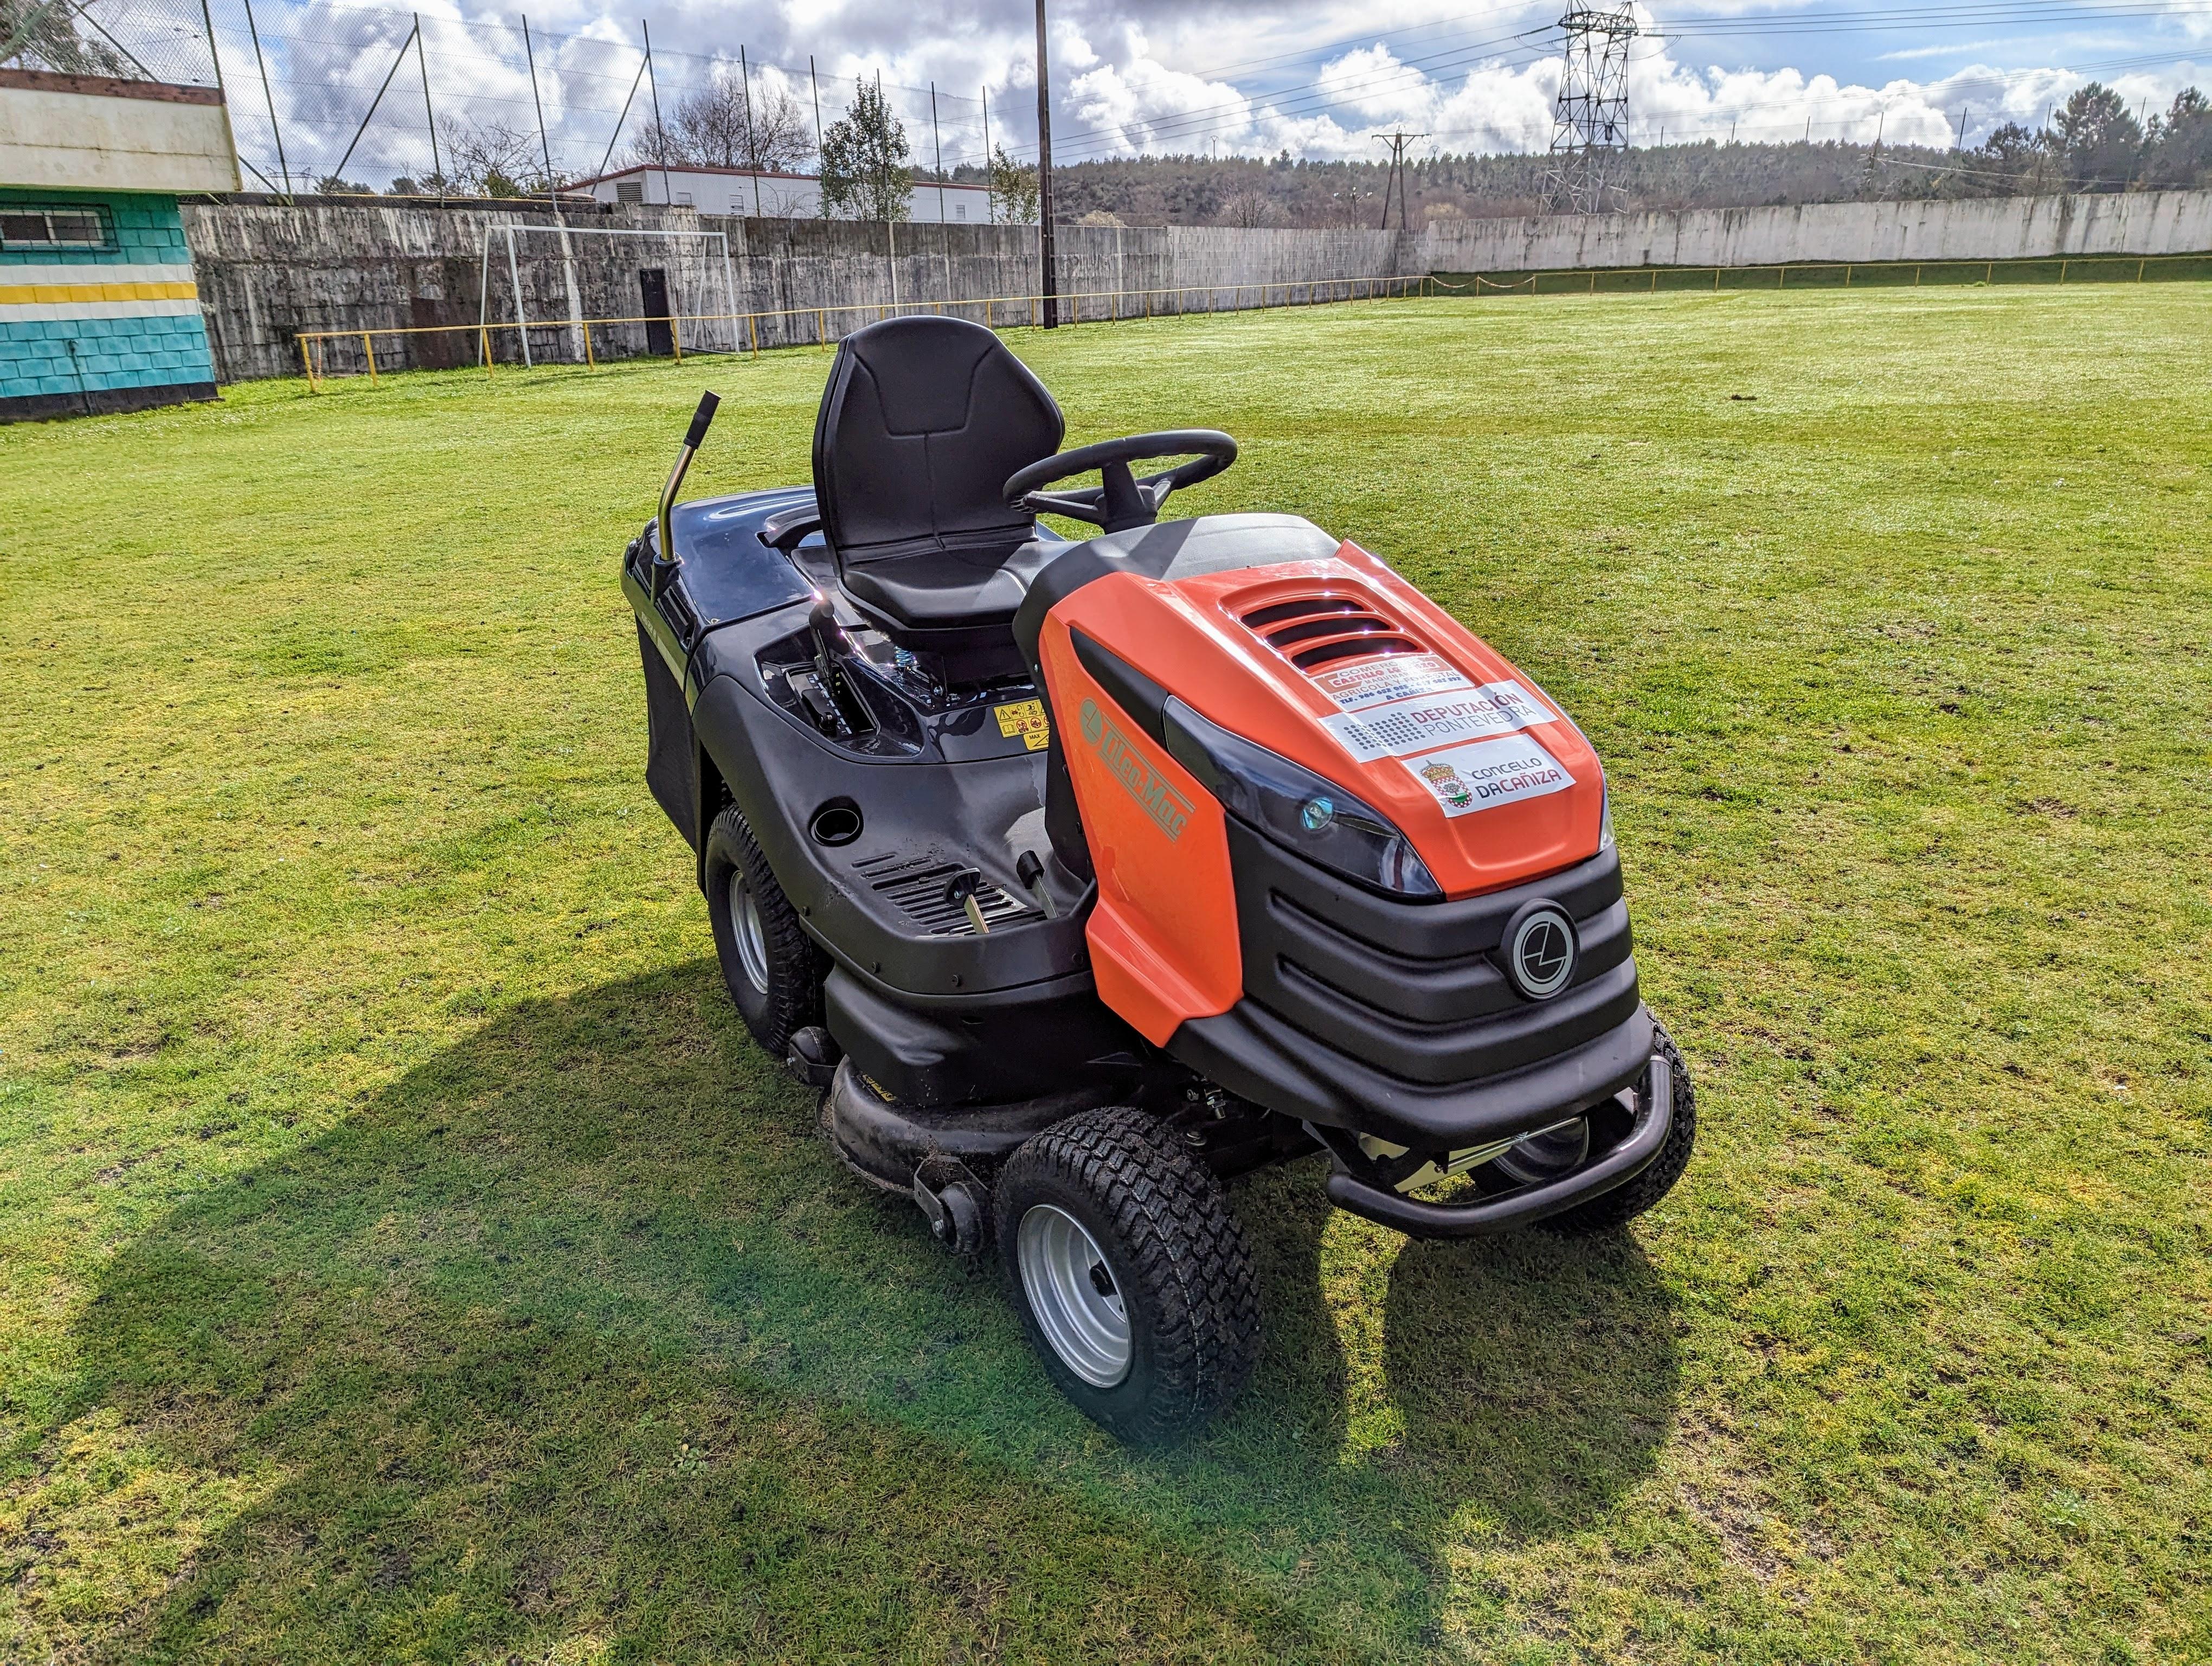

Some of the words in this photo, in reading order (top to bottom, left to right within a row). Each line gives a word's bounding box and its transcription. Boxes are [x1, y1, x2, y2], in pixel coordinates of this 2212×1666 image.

[1333, 670, 1384, 686] CASTILLO
[1333, 681, 1393, 701] AGRICOLA
[1410, 691, 1524, 724] DEPUTACIÓN
[1423, 705, 1537, 736] PONTEVEDRA
[1471, 758, 1542, 780] CONCELLO
